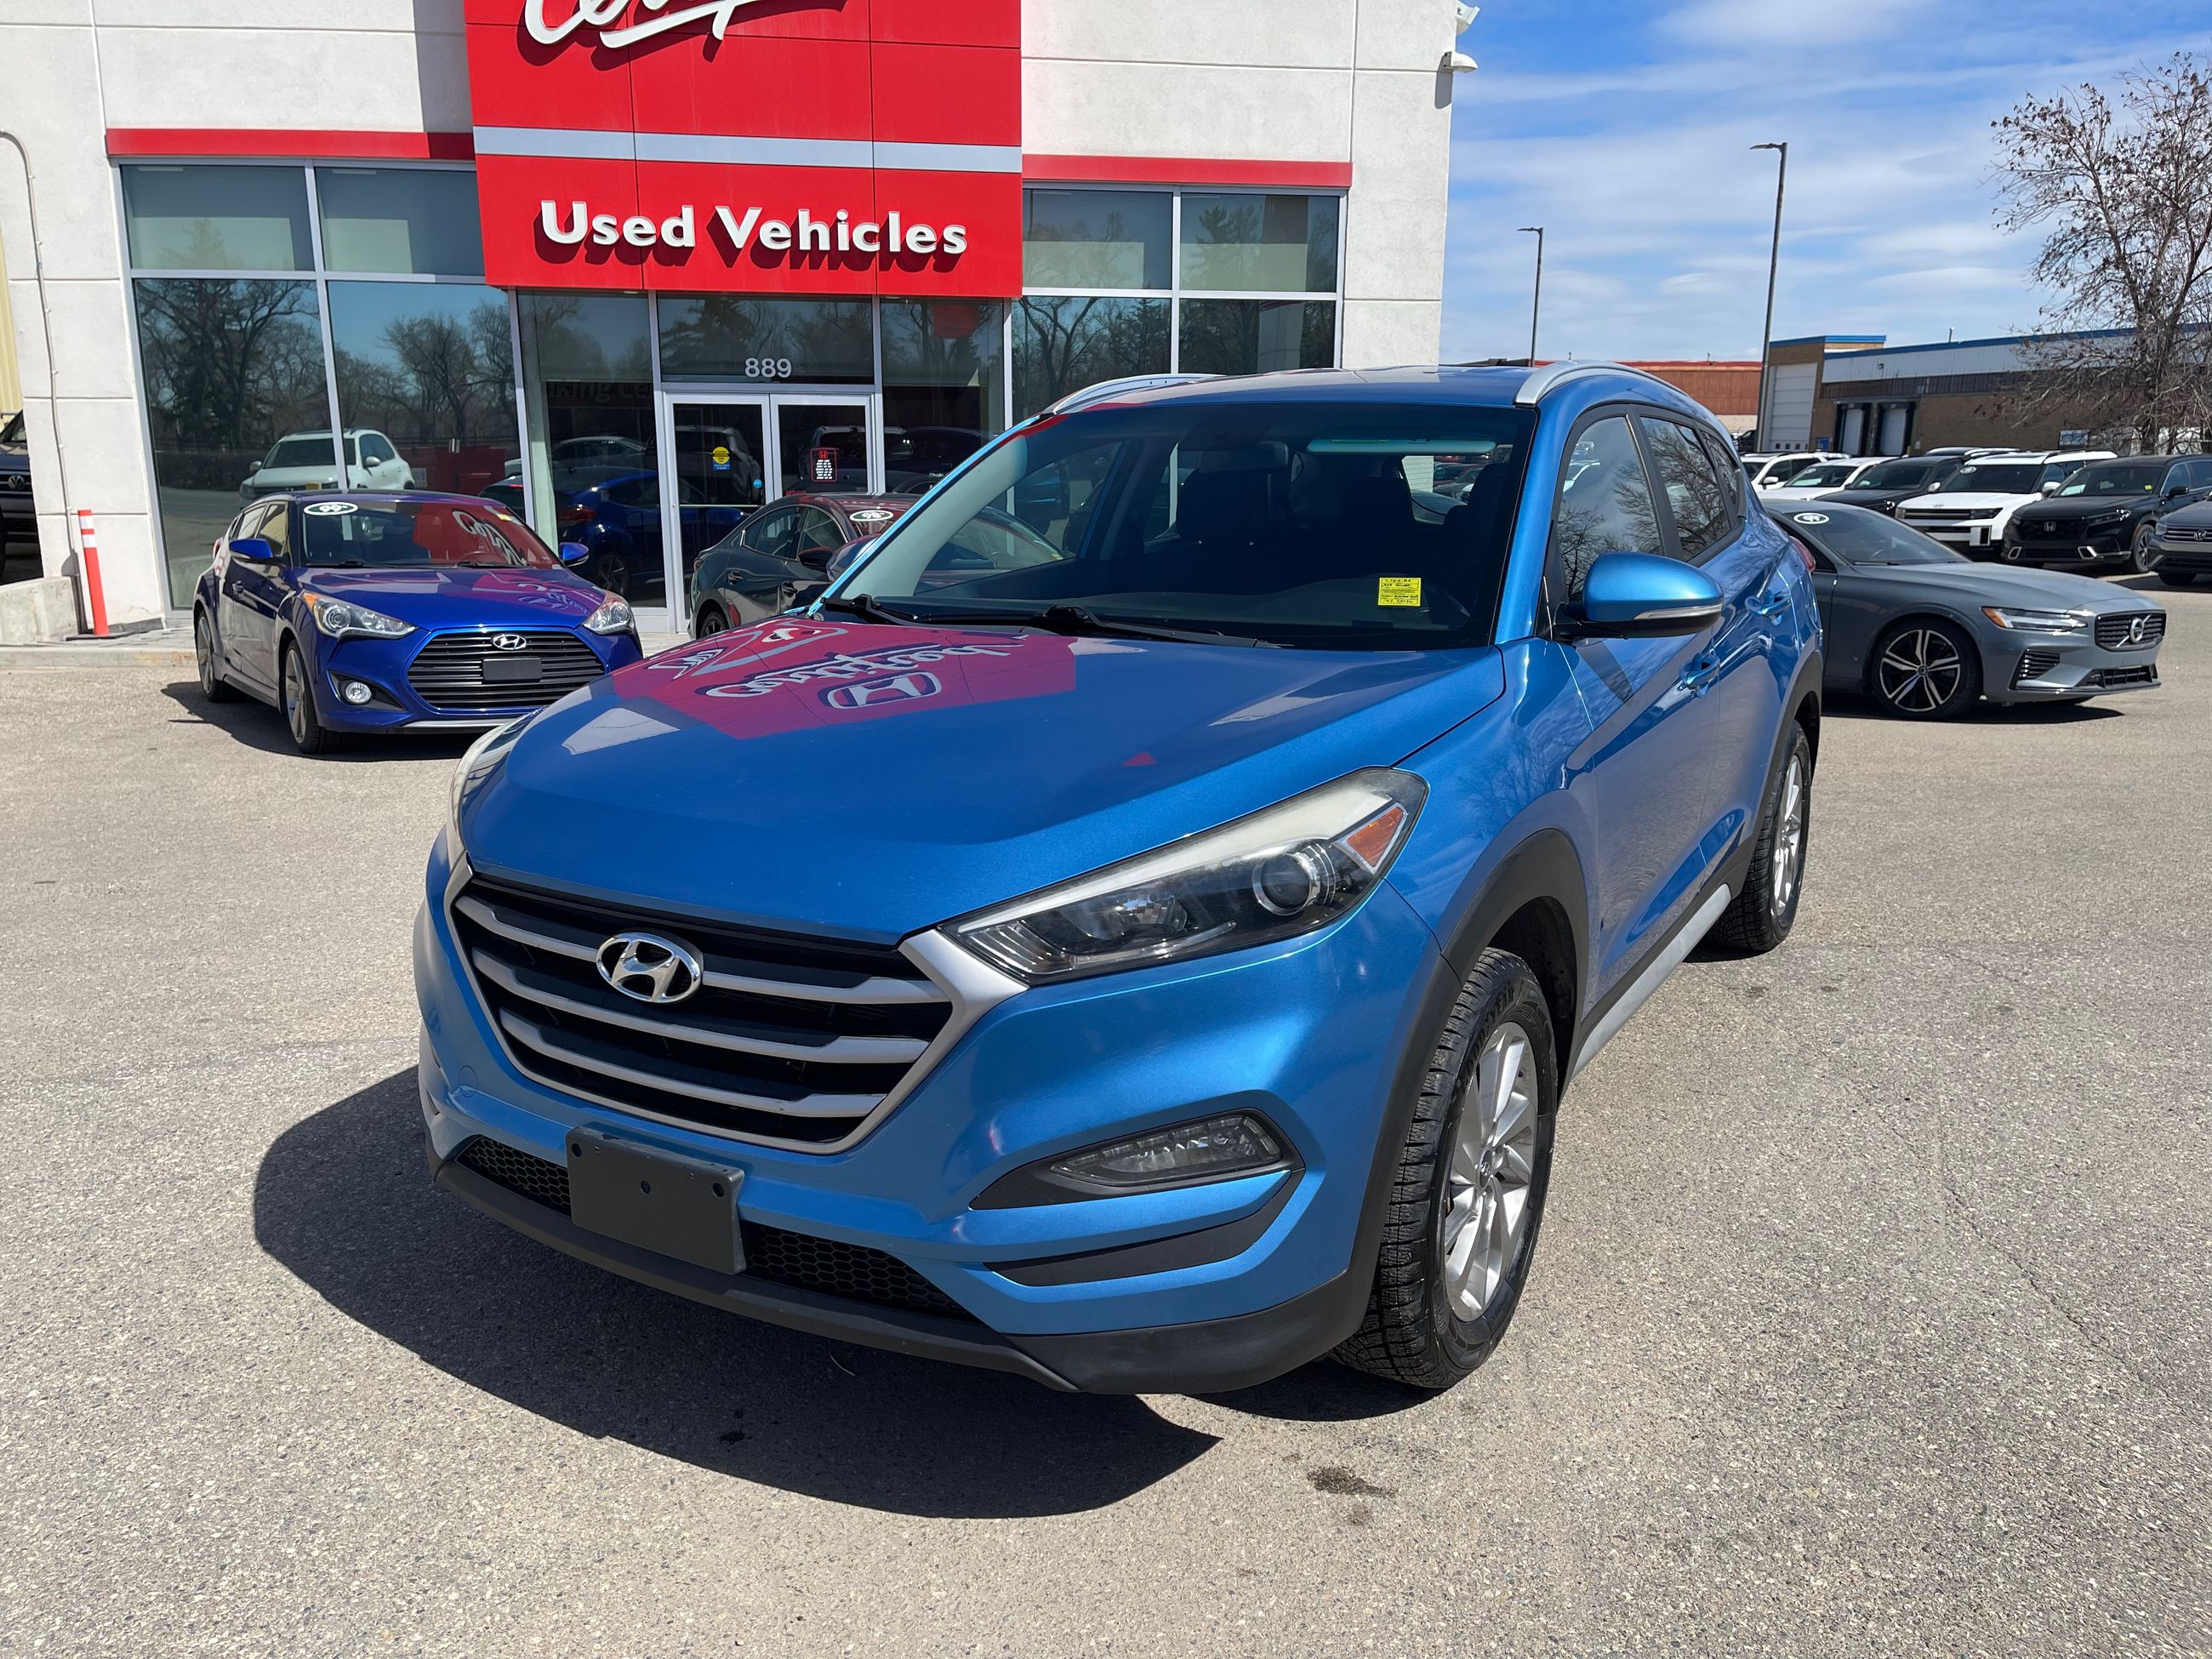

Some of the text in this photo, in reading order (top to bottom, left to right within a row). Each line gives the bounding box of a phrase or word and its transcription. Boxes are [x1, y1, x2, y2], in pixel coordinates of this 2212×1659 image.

[541, 200, 968, 254] Used Vehicles
[744, 357, 792, 379] 889
